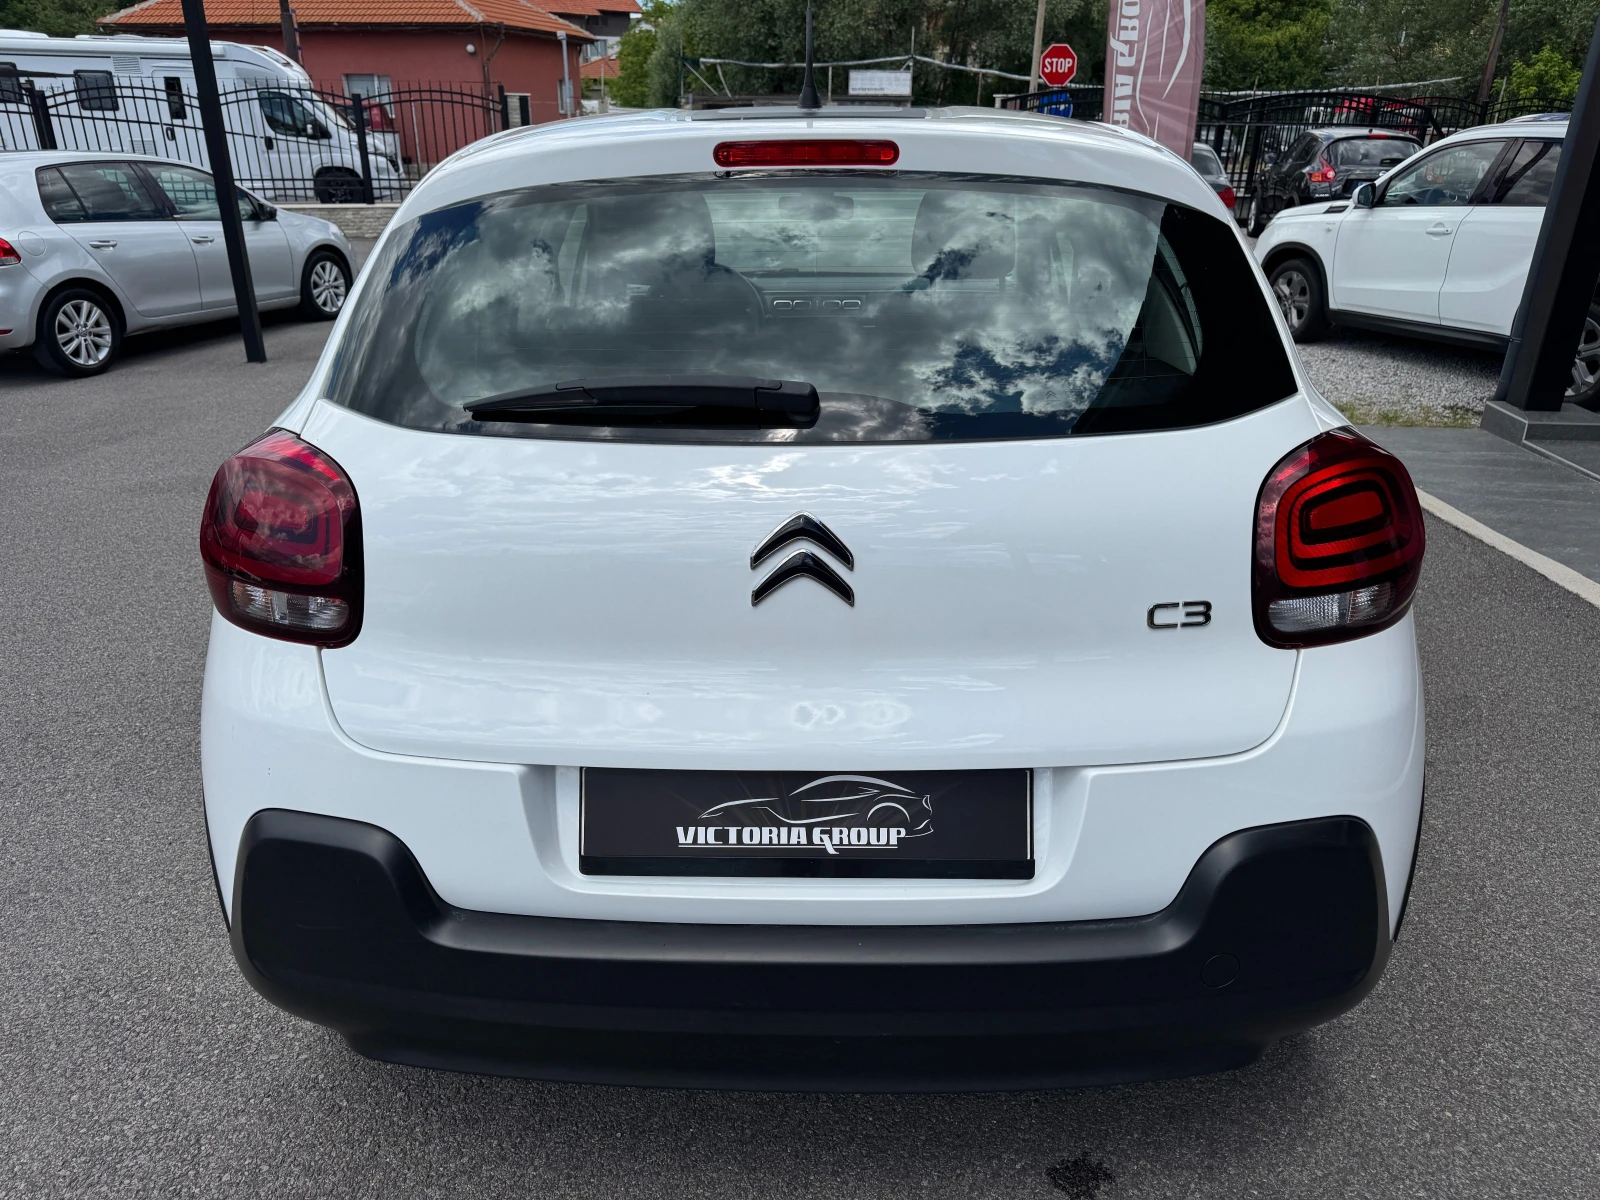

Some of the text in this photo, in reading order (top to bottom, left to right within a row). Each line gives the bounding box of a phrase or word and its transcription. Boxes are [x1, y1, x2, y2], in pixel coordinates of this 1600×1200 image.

[1044, 58, 1073, 73] STOP
[1146, 600, 1212, 629] C3
[676, 826, 906, 854] VICTORIA GROUP
